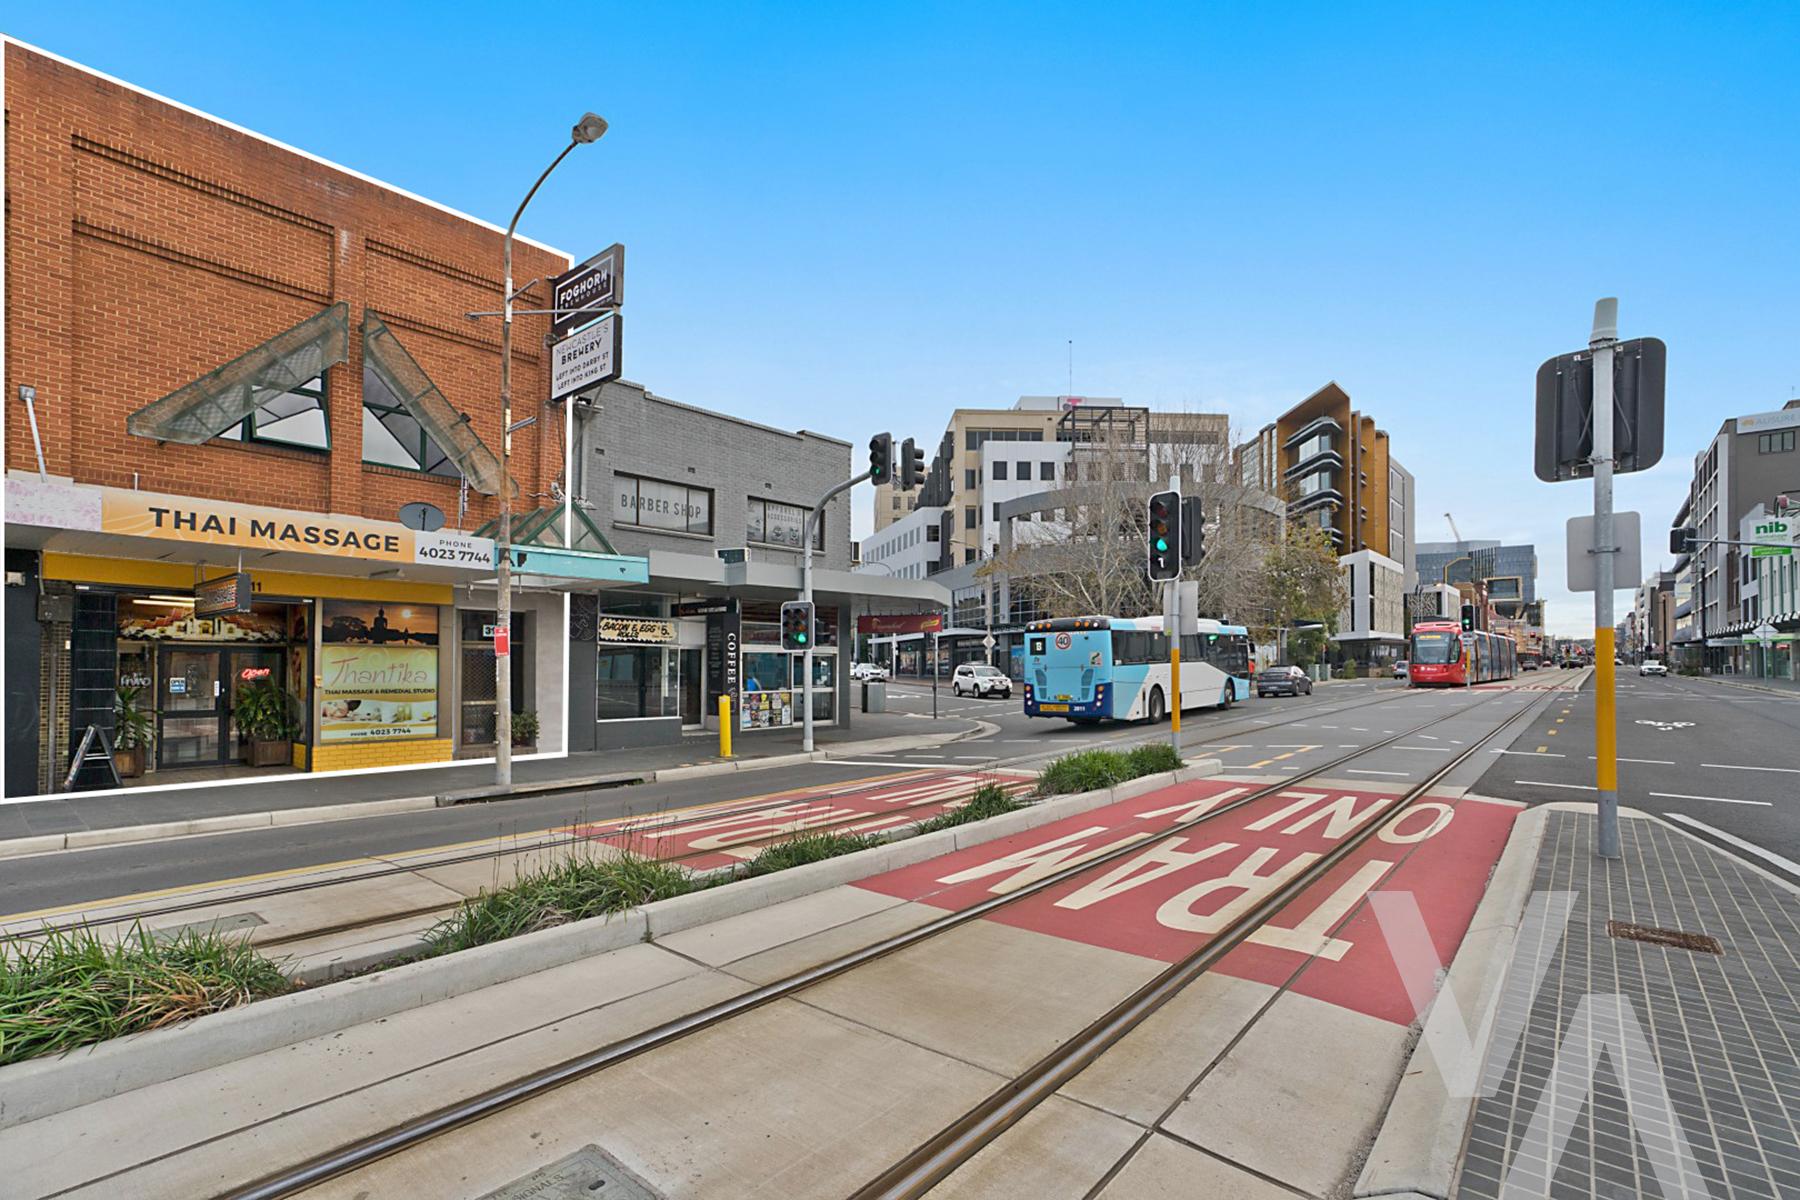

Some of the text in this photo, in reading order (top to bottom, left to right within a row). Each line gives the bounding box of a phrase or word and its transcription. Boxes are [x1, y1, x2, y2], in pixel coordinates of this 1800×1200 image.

[560, 268, 608, 305] FOGHORN
[561, 337, 602, 365] BREWERY
[556, 369, 569, 381] LEFT
[602, 351, 609, 360] ST
[557, 378, 571, 390] LEFT
[599, 362, 606, 372] ST
[621, 494, 702, 519] BARBER SHOP
[148, 507, 400, 552] THAI MASSAGE
[1755, 521, 1788, 534] nib
[419, 546, 455, 560] 4023
[458, 551, 491, 563] 7744
[439, 539, 472, 549] PHONE
[639, 623, 656, 633] EGG
[1059, 636, 1068, 645] 40
[330, 656, 428, 687] Thantika
[727, 631, 737, 684] COFFEE
[1134, 787, 1456, 845] ONLY
[935, 826, 1395, 962] TRAM
